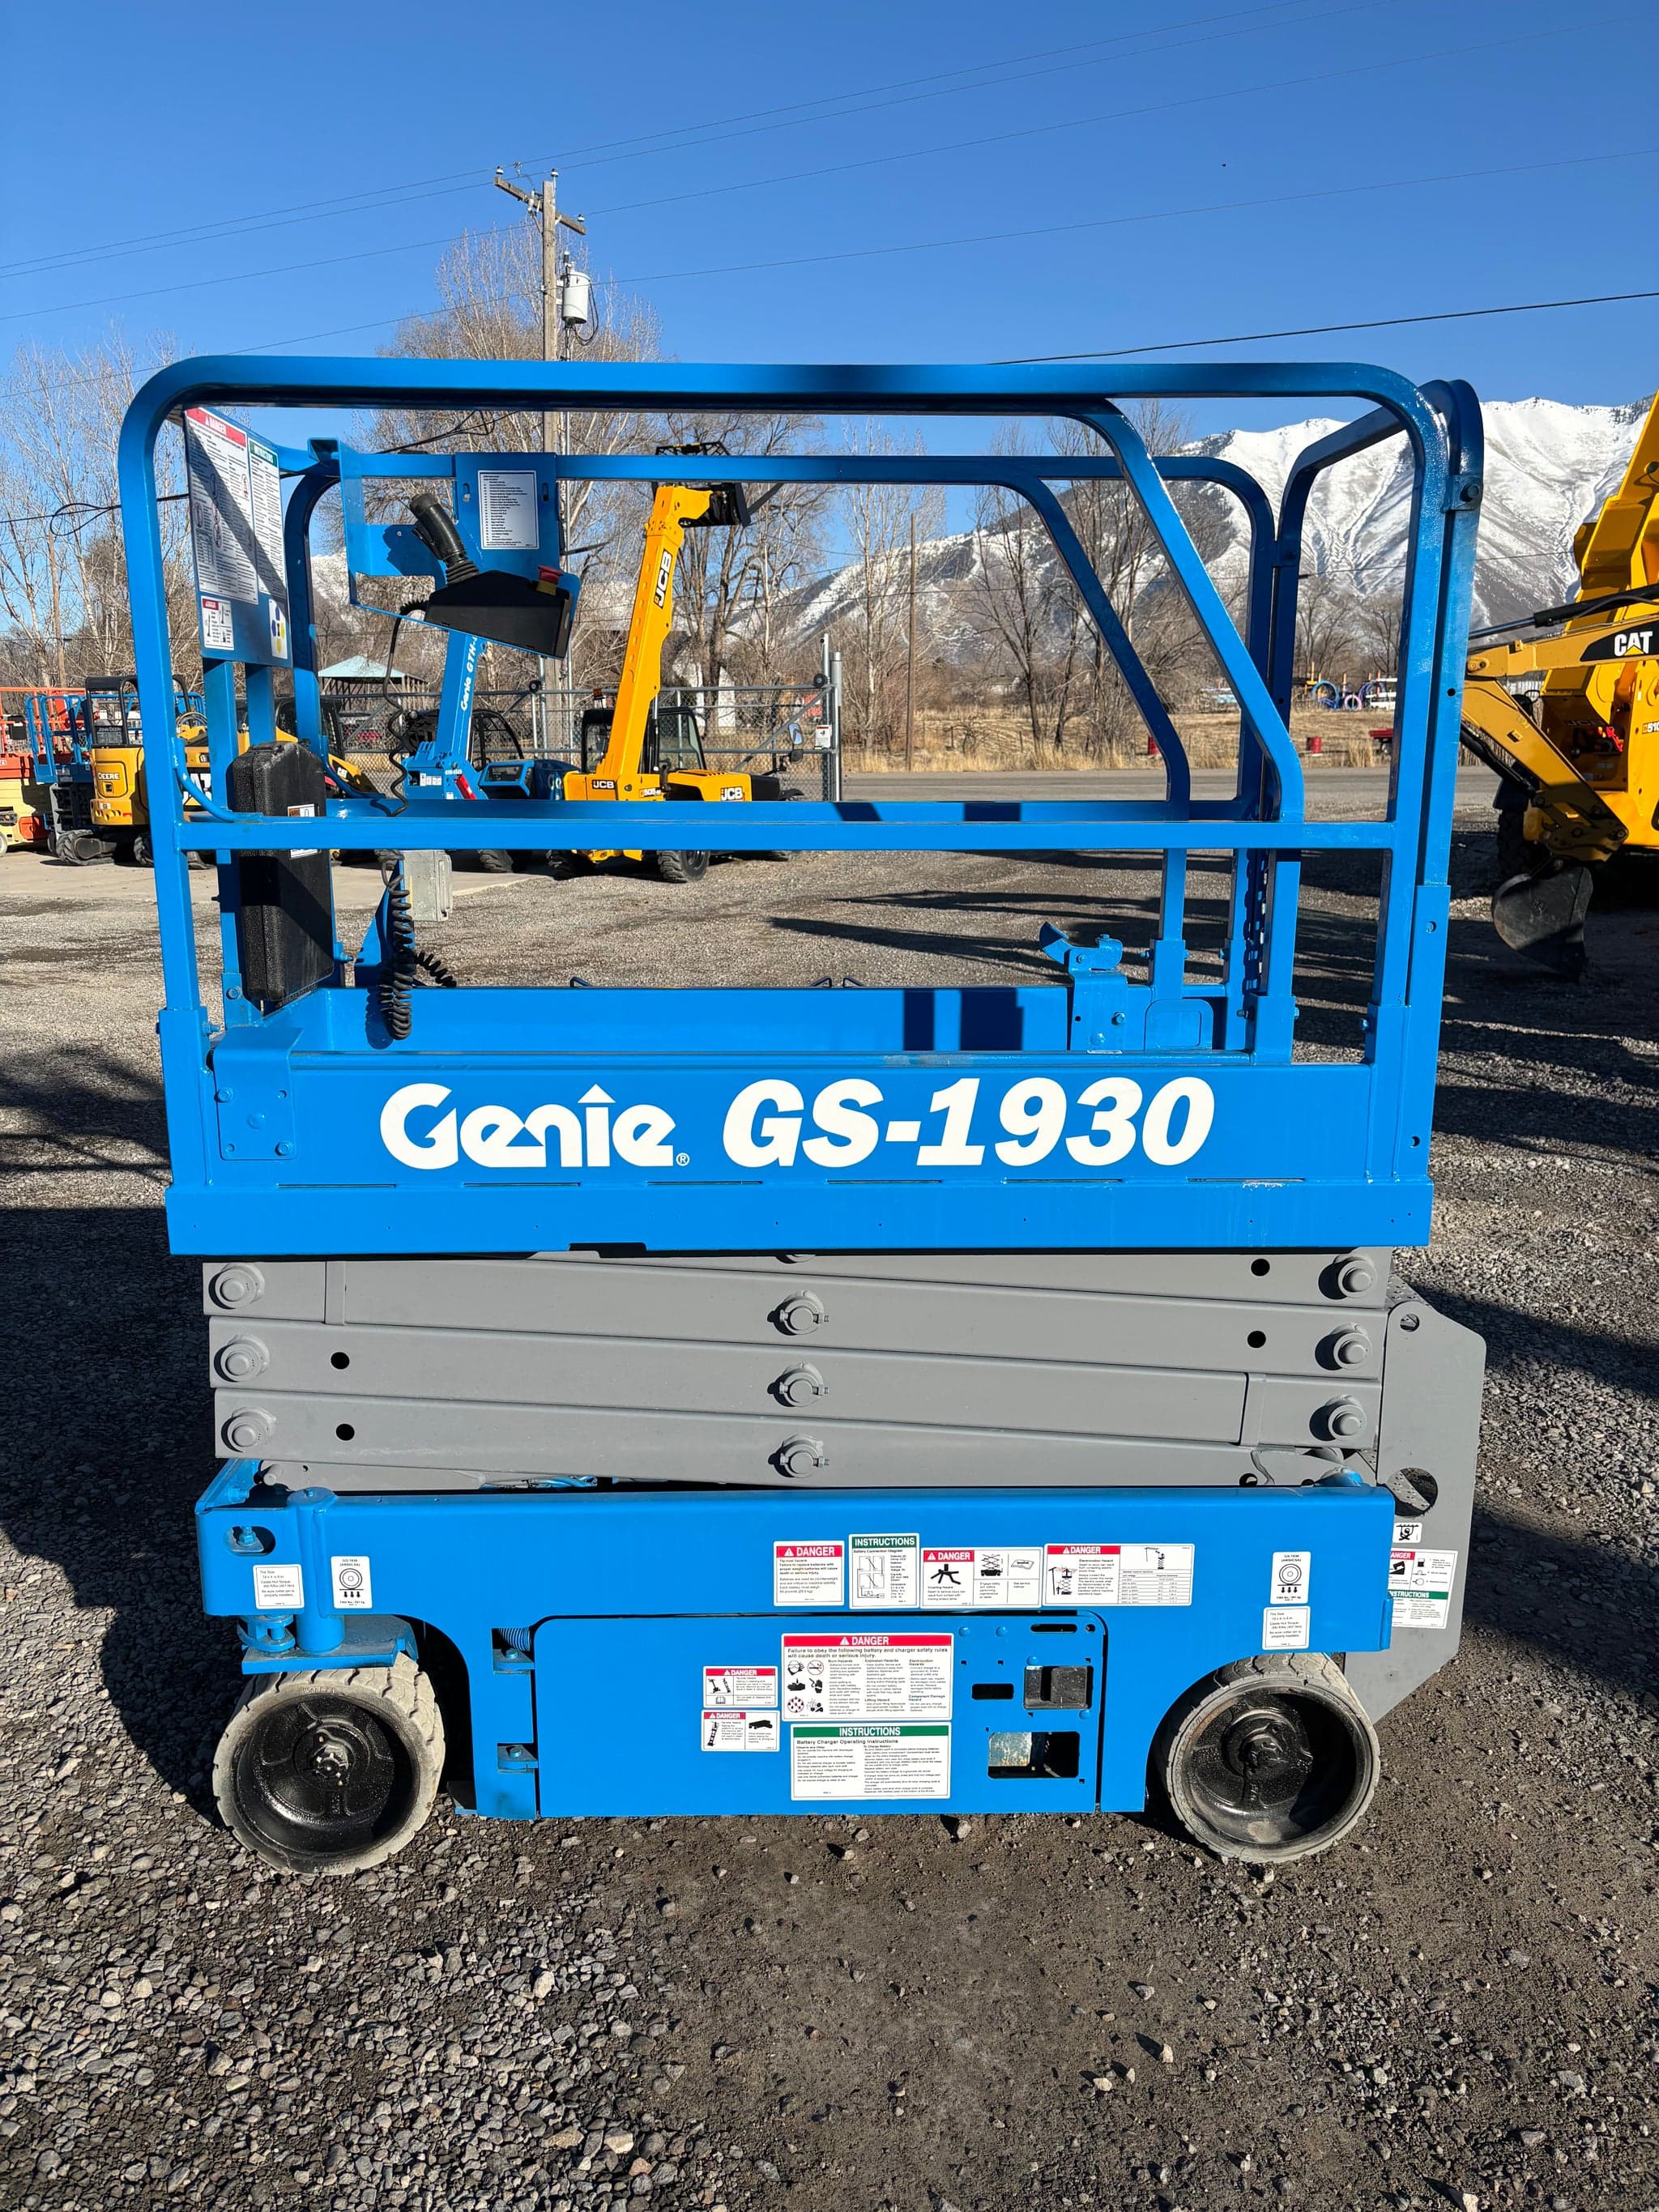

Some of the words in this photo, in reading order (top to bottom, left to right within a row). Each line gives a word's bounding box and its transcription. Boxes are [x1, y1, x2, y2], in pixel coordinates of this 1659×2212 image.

[655, 550, 673, 607] JCB
[1614, 631, 1653, 657] CAT
[460, 676, 471, 711] Genie
[98, 772, 120, 780] DEERE
[592, 780, 615, 789] JCB
[721, 786, 743, 801] JCB
[722, 1076, 1215, 1169] GS-1930
[855, 1536, 915, 1547] INSTRUCTIONS
[795, 1546, 835, 1557] DANGER
[1070, 1546, 1101, 1554] DANGER
[1390, 1551, 1411, 1559] ANGER
[937, 1552, 971, 1561] DANGER
[1388, 1590, 1430, 1598] NSTRUCTIONS
[851, 1636, 889, 1645] DANGER
[838, 1726, 901, 1737] INSTRUCTIONS
